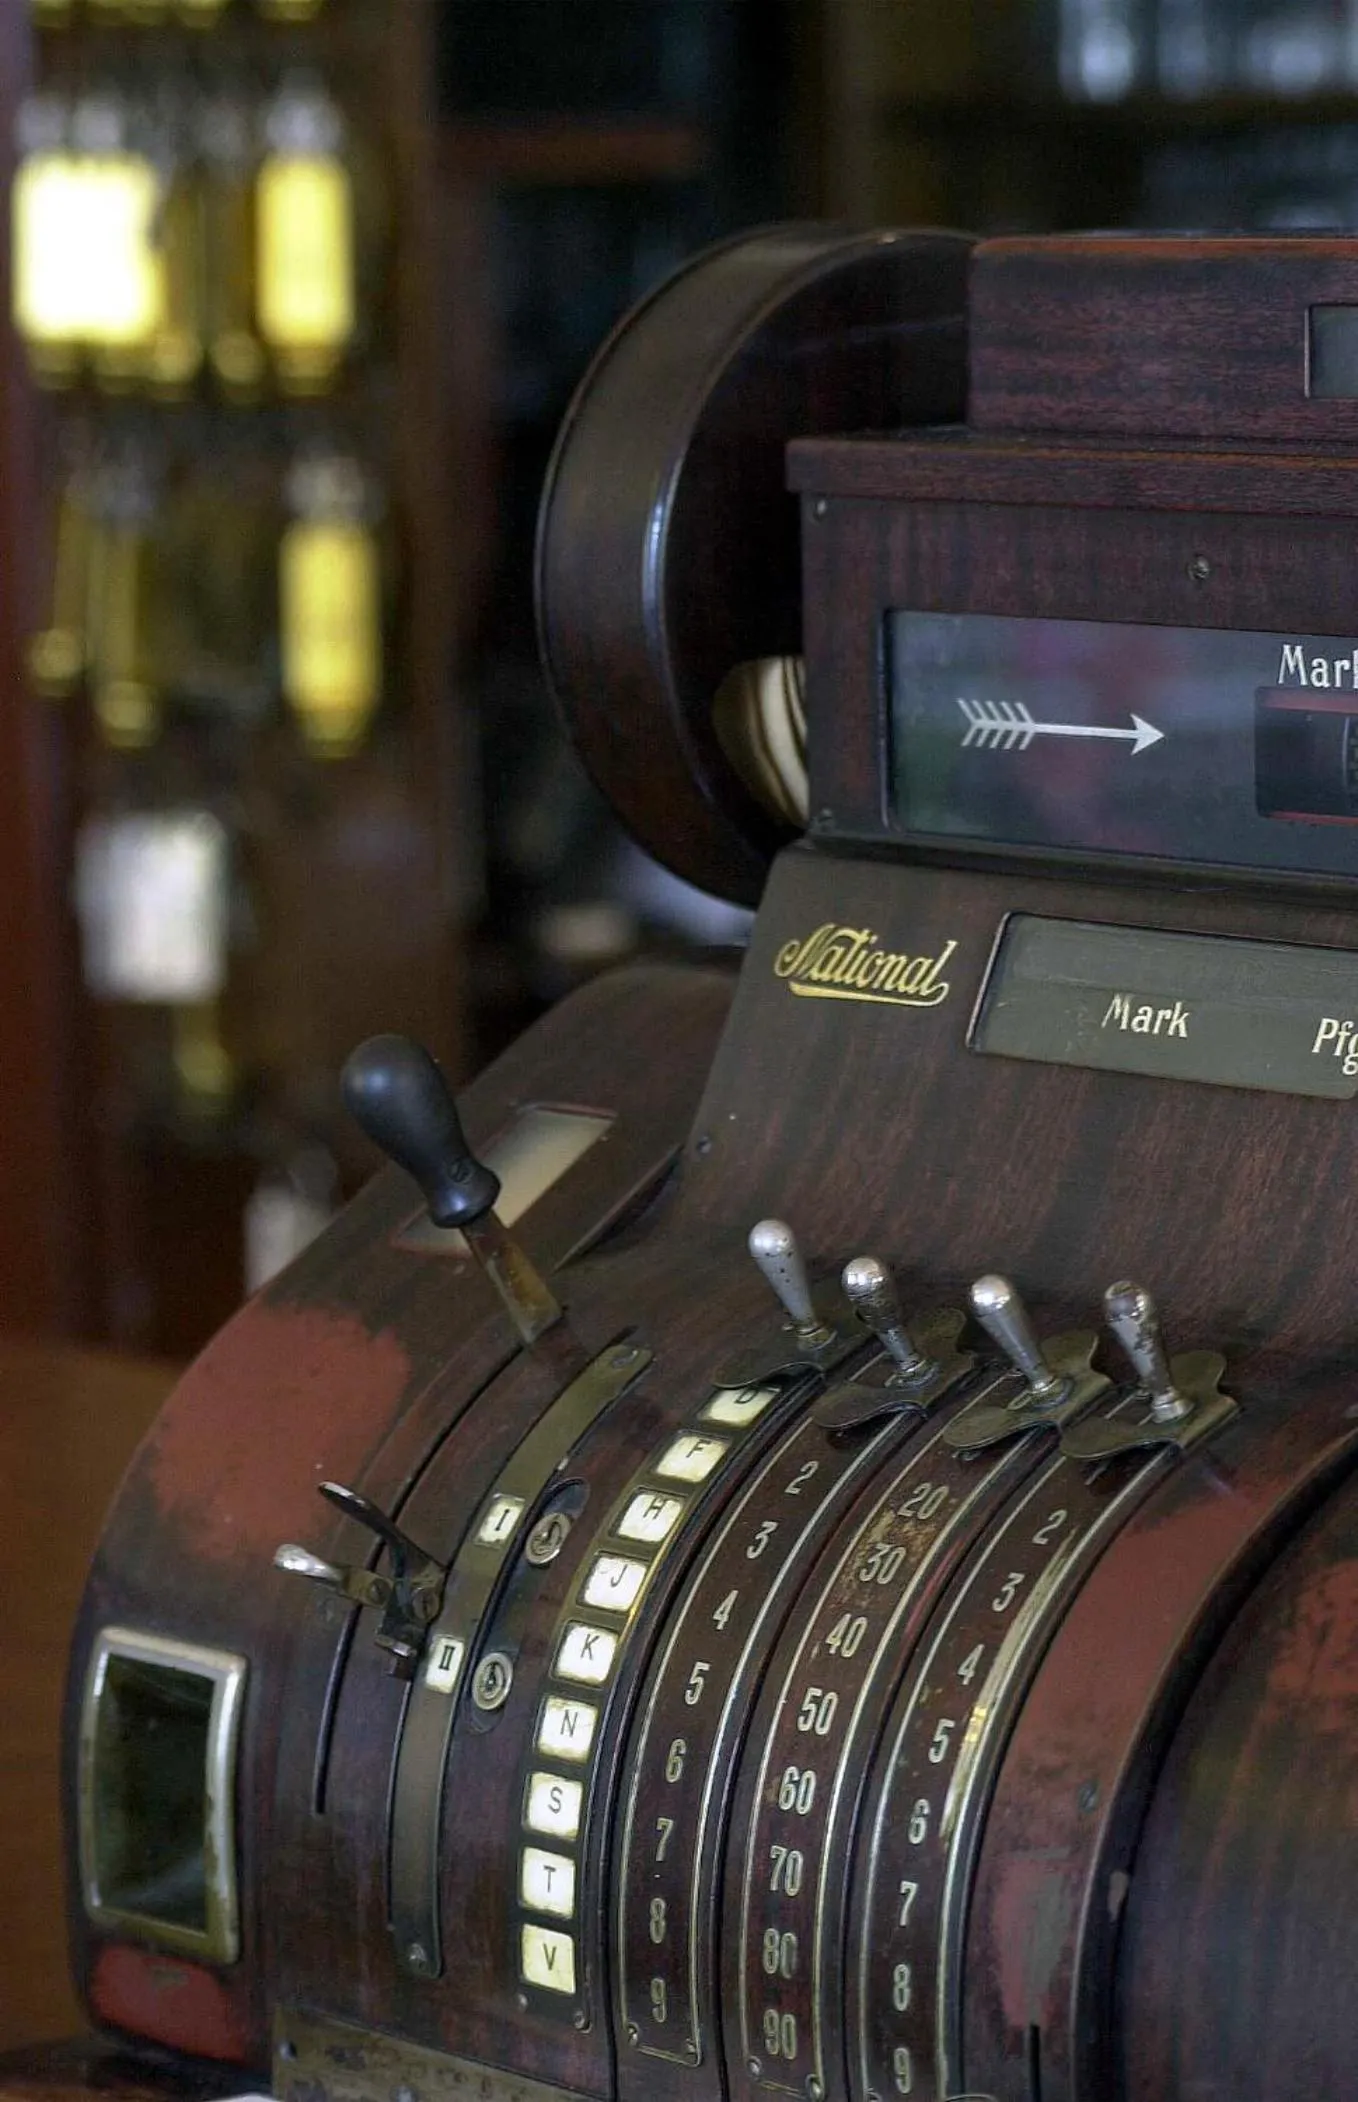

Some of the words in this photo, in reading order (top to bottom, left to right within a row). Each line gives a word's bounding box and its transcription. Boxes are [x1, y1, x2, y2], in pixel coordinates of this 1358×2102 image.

[774, 922, 958, 1007] National
[1102, 993, 1190, 1039] Mark
[685, 1440, 709, 1459] F
[784, 1460, 819, 1495] 2
[643, 1501, 665, 1520] H
[898, 1482, 951, 1520] 20
[746, 1521, 778, 1559] 3
[1032, 1509, 1067, 1545] 2
[610, 1564, 630, 1588] J
[859, 1543, 906, 1585] 30
[712, 1590, 739, 1630] 4
[992, 1572, 1025, 1612] 3
[580, 1632, 599, 1661] K
[825, 1613, 868, 1659] 40
[684, 1661, 711, 1706] 5
[958, 1643, 985, 1685] 4
[560, 1709, 581, 1737] N
[797, 1687, 838, 1737] 50
[665, 1738, 687, 1783] 6
[928, 1719, 955, 1763] 5
[547, 1786, 564, 1814] S
[778, 1766, 816, 1815] 60
[655, 1818, 674, 1862] 7
[908, 1798, 930, 1844] 6
[544, 1865, 556, 1893] T
[769, 1845, 803, 1897] 70
[649, 1897, 667, 1944] 8
[899, 1880, 919, 1926] 7
[542, 1943, 556, 1972] V
[762, 1928, 799, 1979] 80
[650, 1977, 668, 2023] 9
[893, 1963, 912, 2011] 8
[763, 2008, 797, 2060] 90
[893, 2047, 912, 2094] 9
